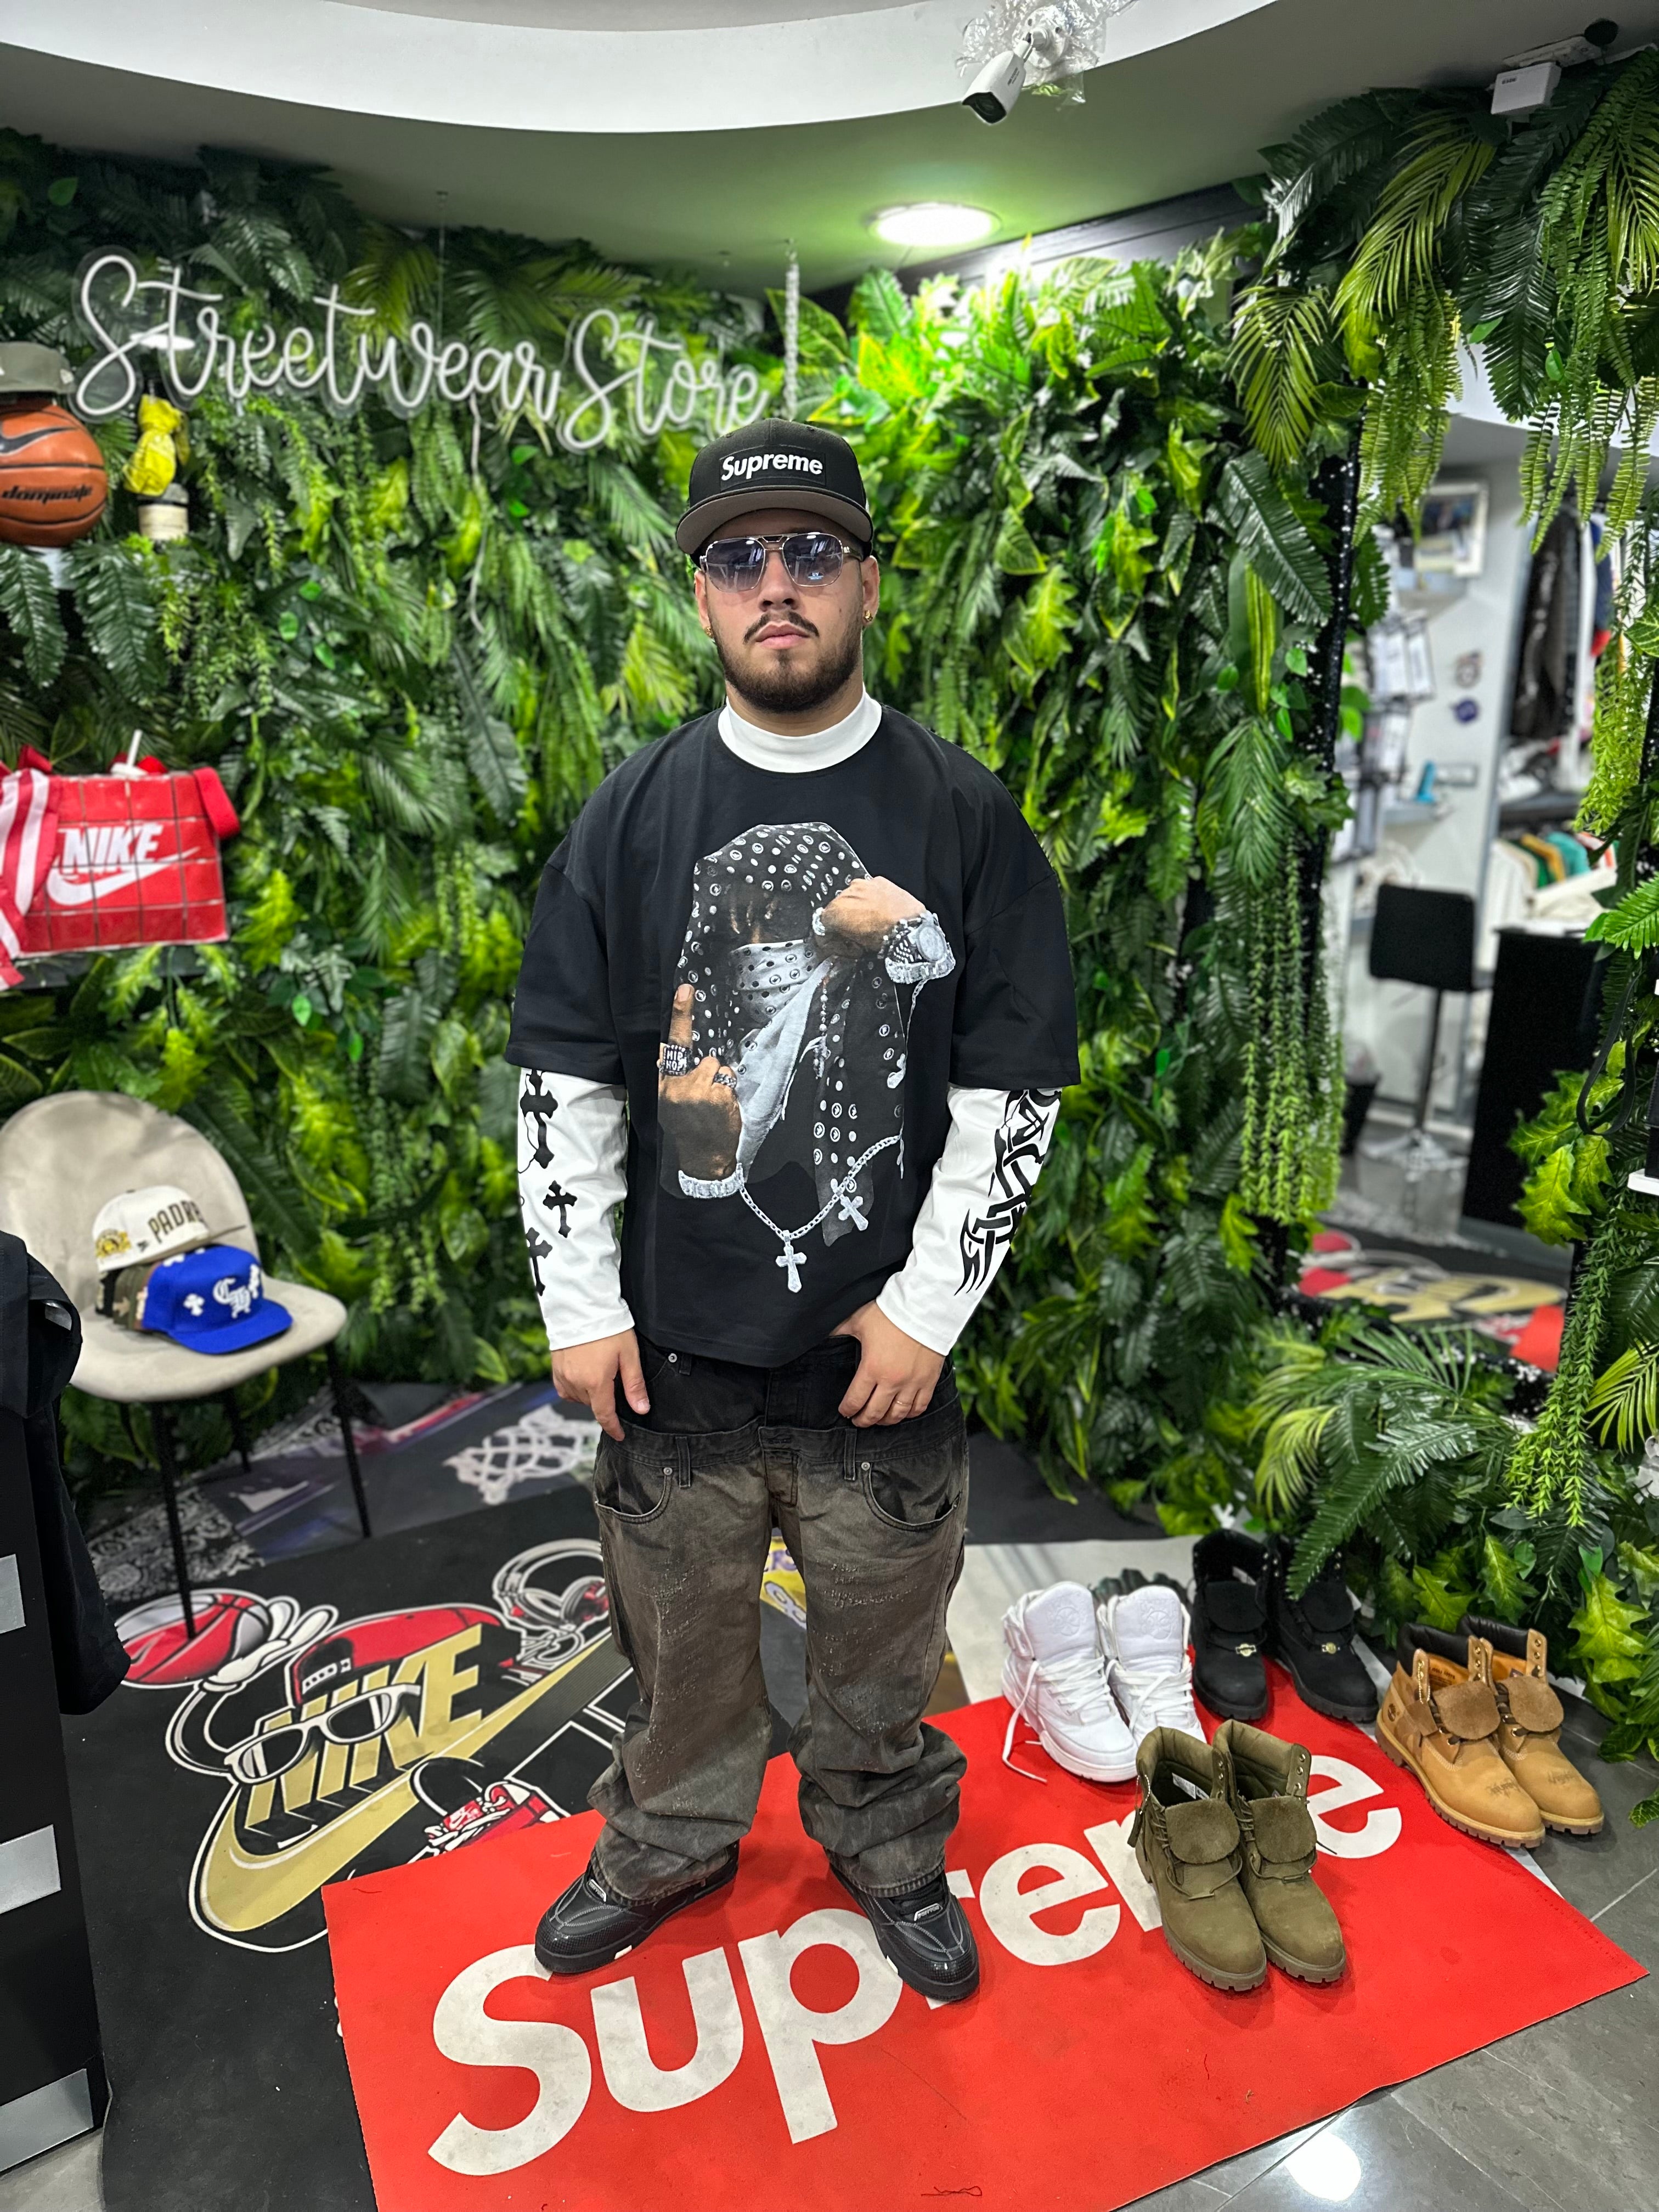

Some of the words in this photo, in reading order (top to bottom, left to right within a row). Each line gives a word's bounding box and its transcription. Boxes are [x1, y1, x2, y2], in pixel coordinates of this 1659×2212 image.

[76, 255, 560, 422] Streetwear
[563, 308, 769, 449] Store
[721, 454, 823, 481] Supreme
[57, 823, 164, 876] NIKE
[667, 1050, 684, 1061] HIP
[427, 1755, 1402, 2175] Supee
